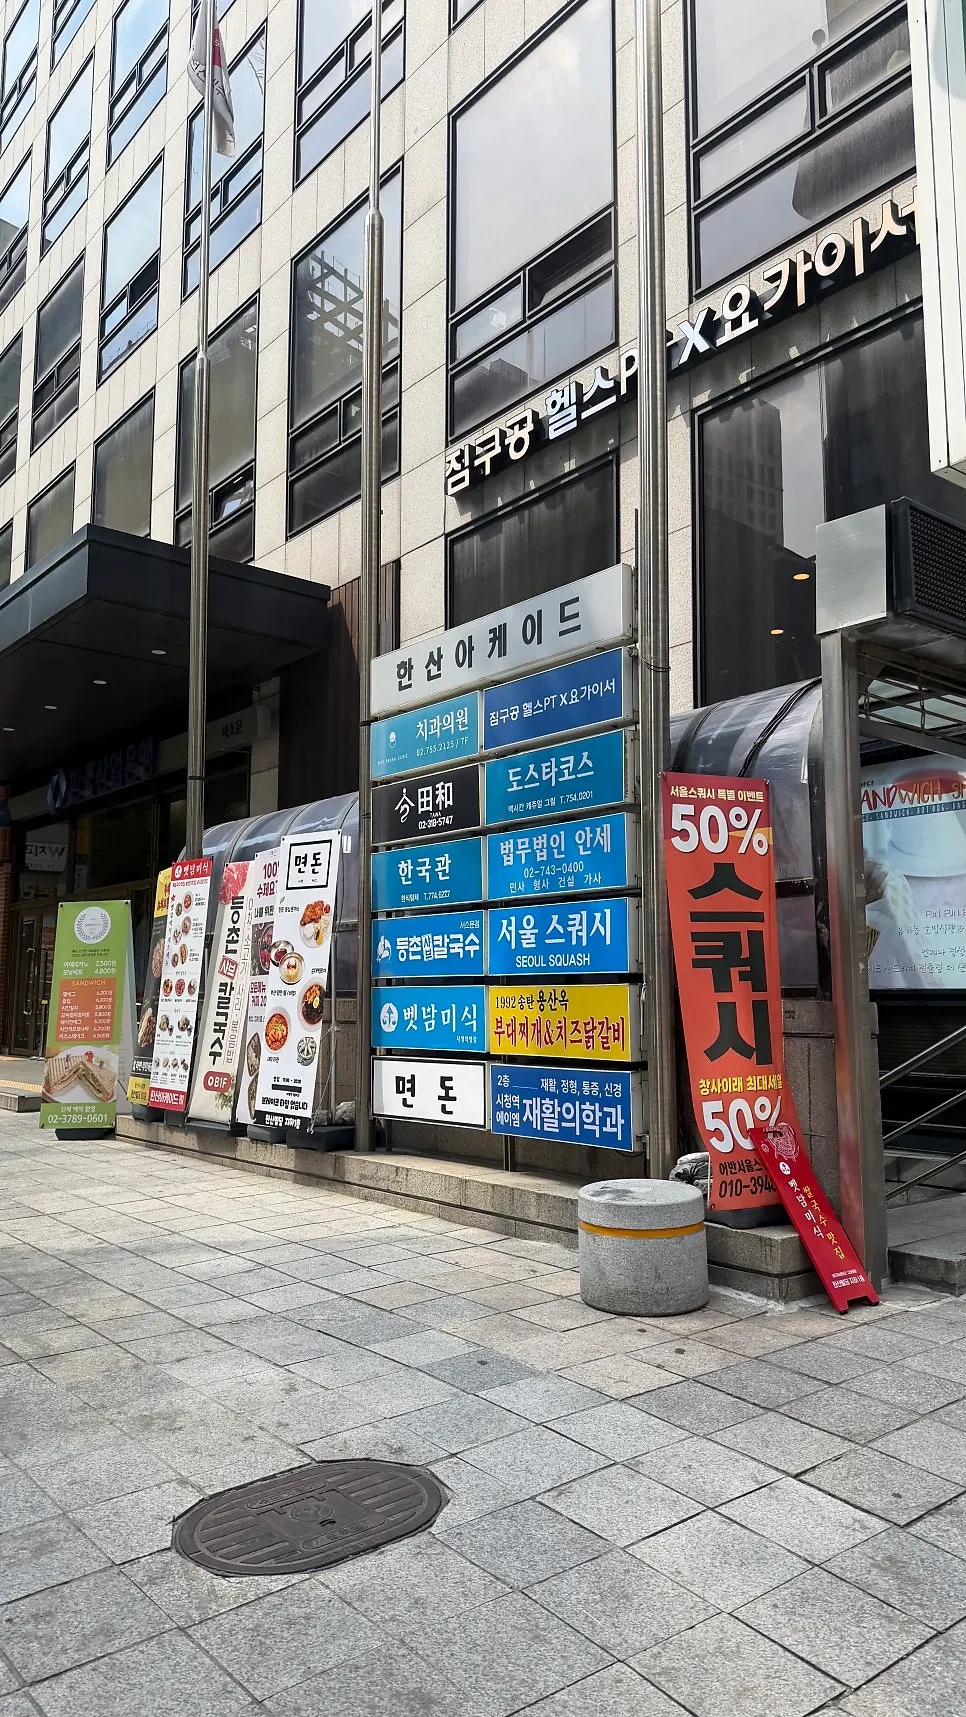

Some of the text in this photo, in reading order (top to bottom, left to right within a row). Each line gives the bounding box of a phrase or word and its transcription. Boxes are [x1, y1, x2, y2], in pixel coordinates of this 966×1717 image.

[445, 406, 538, 496] 짐구공
[396, 596, 582, 692] 한산아케이드
[489, 705, 520, 727] 짐구공
[522, 694, 557, 718] 헬스PT
[568, 677, 616, 705] 요가이서
[415, 706, 469, 742] 치과의원
[506, 751, 595, 793] 도스타코스
[417, 781, 454, 815] 田和
[669, 785, 765, 803] 서울스쿼시 특별 이벤트
[861, 779, 943, 811] ANDWICH
[418, 815, 454, 830] 02-318-5747
[670, 803, 769, 856] 50%
[500, 823, 611, 867] 법무법인 안세
[263, 861, 280, 880] 100
[294, 852, 322, 875] 면돈
[397, 853, 452, 885] 한국관
[523, 860, 585, 879] 02-743-0400
[256, 880, 278, 898] 수제요
[509, 872, 602, 894] 민사 형사 건설 가사
[497, 908, 611, 950] 서울 스쿼시
[515, 953, 591, 968] SEOUL SQUASH
[687, 862, 773, 1066] 스쿼시
[71, 979, 106, 987] SANDWICH
[495, 988, 570, 1013] 1992 송탄 용산옥
[402, 1003, 477, 1033] 벳남미식
[493, 1015, 626, 1052] 부대찌개&치즈닭갈비
[497, 1074, 511, 1088] 2층
[604, 1082, 622, 1098] 신경
[699, 1076, 743, 1096] 창사이래
[495, 1093, 520, 1110] 시청역
[47, 1113, 108, 1124] 02-3789-0601
[495, 1110, 520, 1128] 에이엠
[522, 1097, 625, 1141] 재활의학과
[719, 1159, 767, 1176] 어반서울스
[826, 1232, 846, 1260] 맛집
